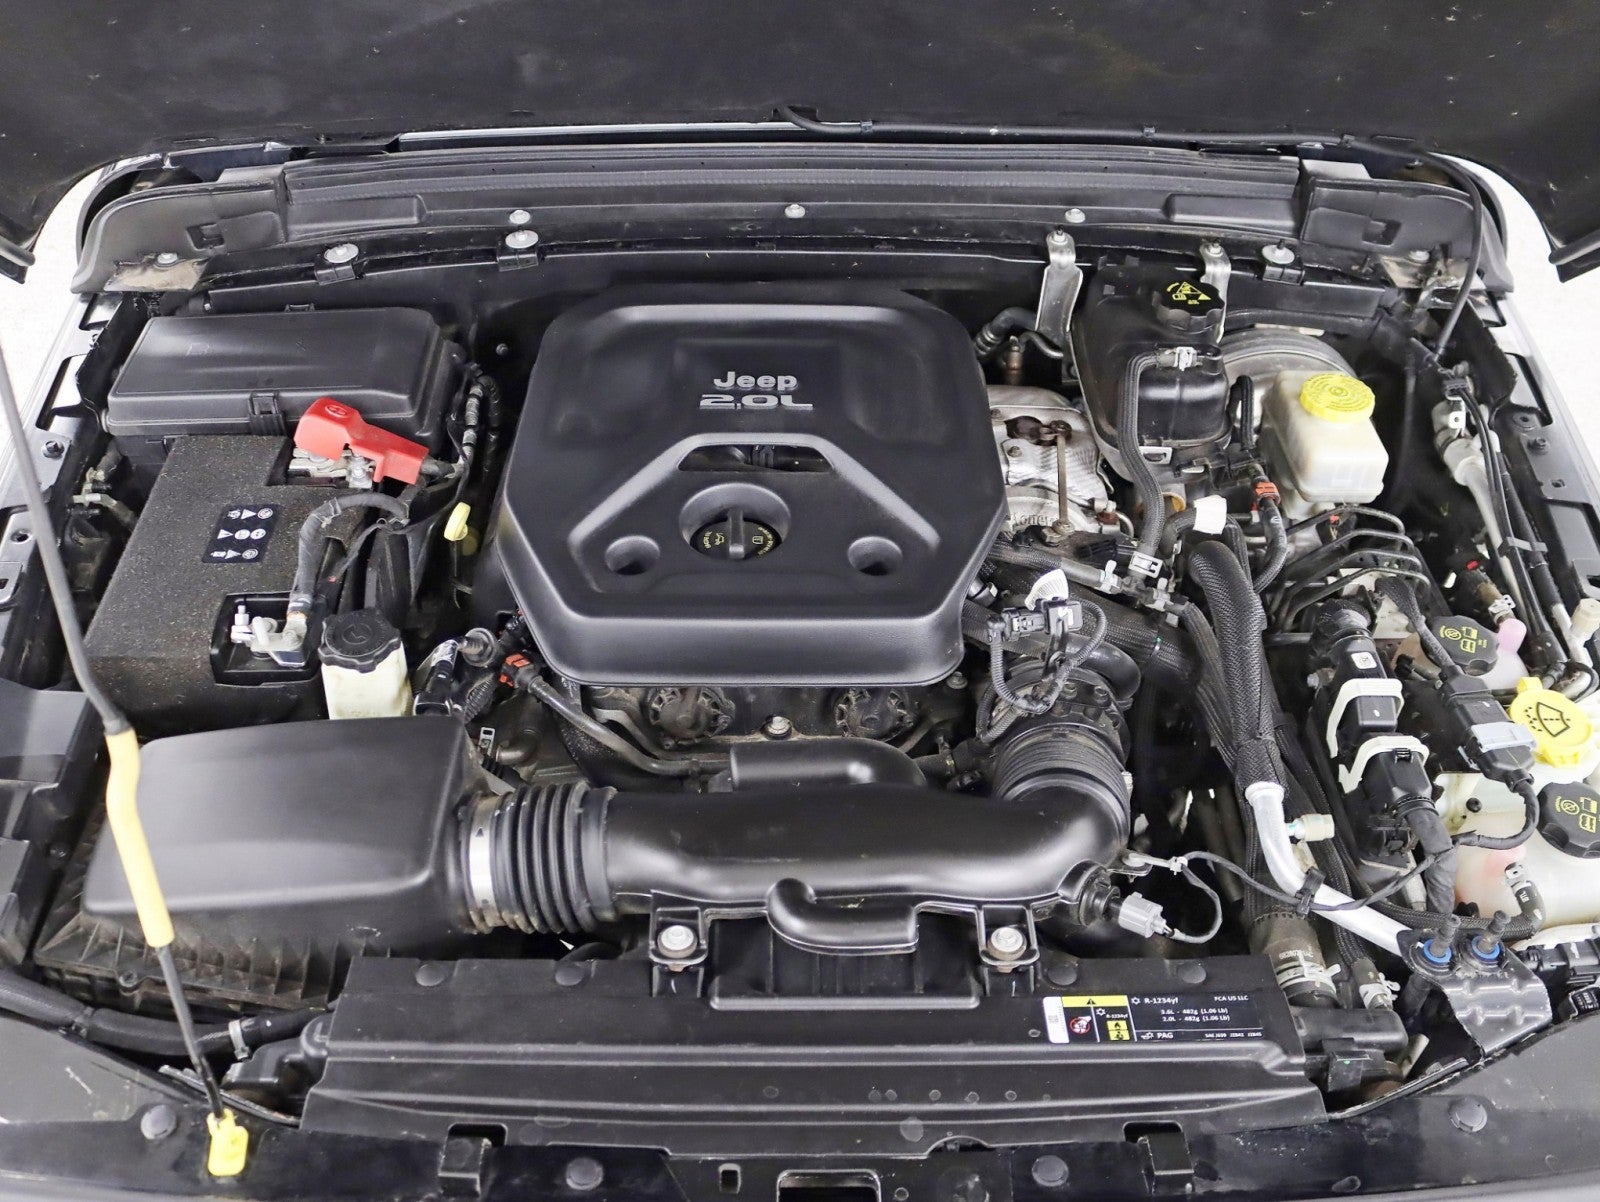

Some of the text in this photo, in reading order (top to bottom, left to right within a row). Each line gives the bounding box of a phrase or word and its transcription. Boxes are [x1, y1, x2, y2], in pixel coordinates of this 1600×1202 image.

[713, 371, 798, 391] Jeep
[699, 393, 814, 411] 2.0L
[1144, 997, 1179, 1005] R-1234yf
